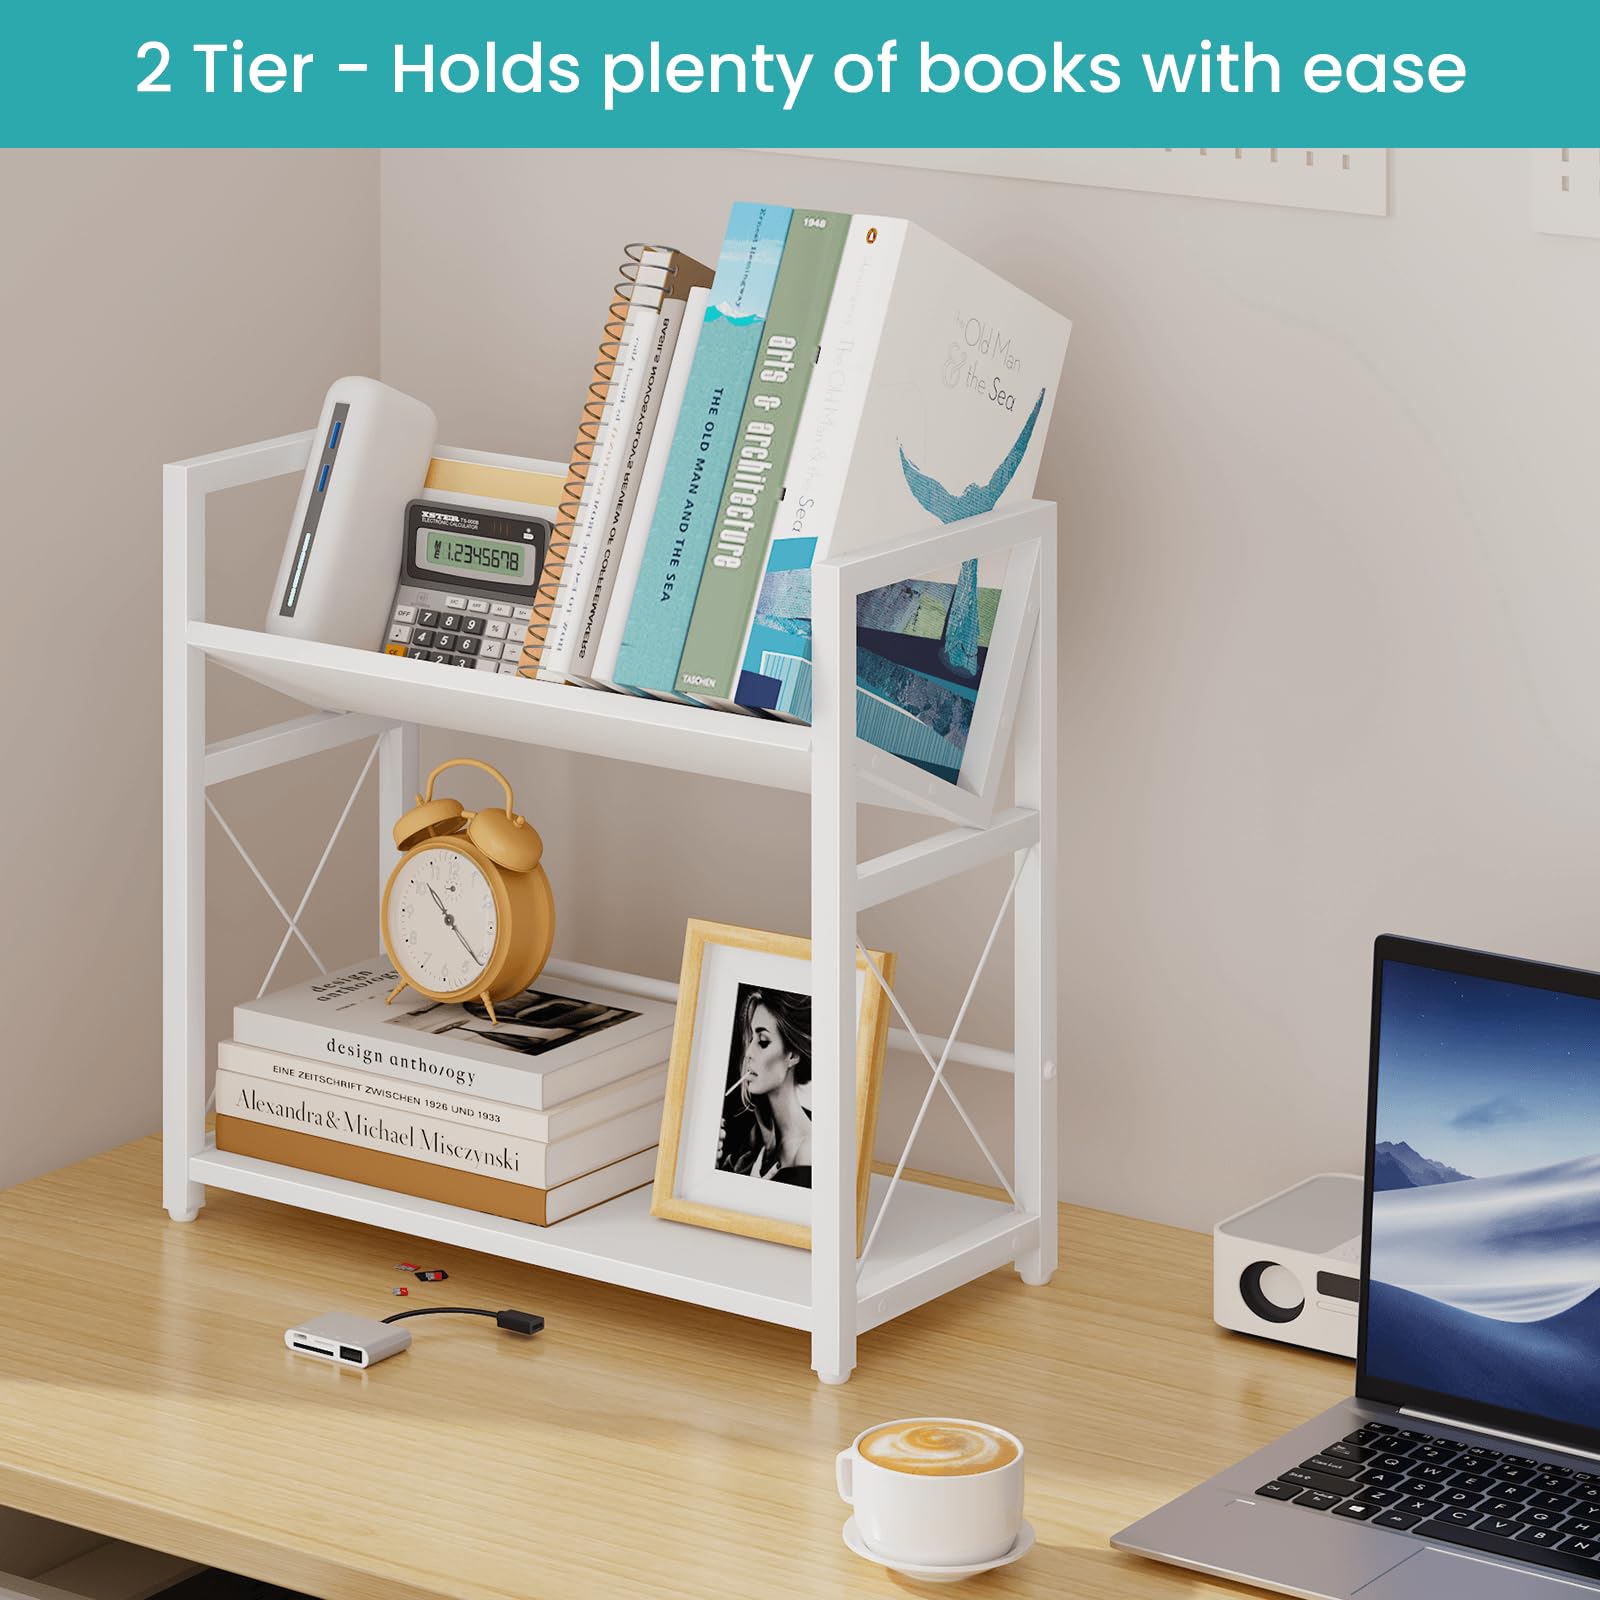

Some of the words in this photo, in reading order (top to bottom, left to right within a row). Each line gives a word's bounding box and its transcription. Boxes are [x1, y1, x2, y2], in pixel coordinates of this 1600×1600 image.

[964, 318, 994, 355] Old
[992, 330, 1021, 373] Man
[760, 335, 797, 383] arts
[966, 360, 986, 394] the
[988, 376, 1016, 412] Sea
[708, 387, 724, 415] THE
[753, 395, 782, 412] &
[700, 421, 715, 452] OLD
[688, 458, 706, 494] MAN
[712, 421, 776, 569] architecture
[679, 499, 695, 533] AND
[792, 495, 815, 532] Sea
[447, 542, 519, 571] 1.2345678
[670, 538, 686, 568] THE
[660, 573, 676, 602] SEA
[397, 610, 411, 618] OFF
[423, 612, 432, 622] 7
[445, 616, 454, 626] 8
[467, 620, 476, 630] 9
[417, 632, 427, 642] 4
[440, 635, 449, 646] 5
[462, 639, 471, 649] 6
[414, 651, 420, 660] 1
[436, 655, 444, 664] 2
[459, 659, 466, 668] 3
[312, 970, 373, 993] design
[327, 1038, 383, 1065] design
[389, 1053, 476, 1087] anthology
[273, 1065, 296, 1077] EINE
[298, 1070, 362, 1092] ZEITSCHRIFT
[365, 1085, 421, 1106] ZWISCHEN
[425, 1099, 449, 1112] 1926
[451, 1104, 475, 1117] UND
[478, 1111, 501, 1123] 1933
[235, 1088, 323, 1127] Alexandra
[325, 1110, 341, 1131] &
[343, 1111, 414, 1147] Michael
[420, 1128, 520, 1172] Misczynski
[1384, 1458, 1400, 1466] Q
[1423, 1467, 1442, 1475] W
[1371, 1491, 1386, 1499] Z
[1505, 1486, 1517, 1494] R
[1411, 1501, 1425, 1509] X
[1575, 1523, 1591, 1531] H
[1534, 1531, 1547, 1539] B
